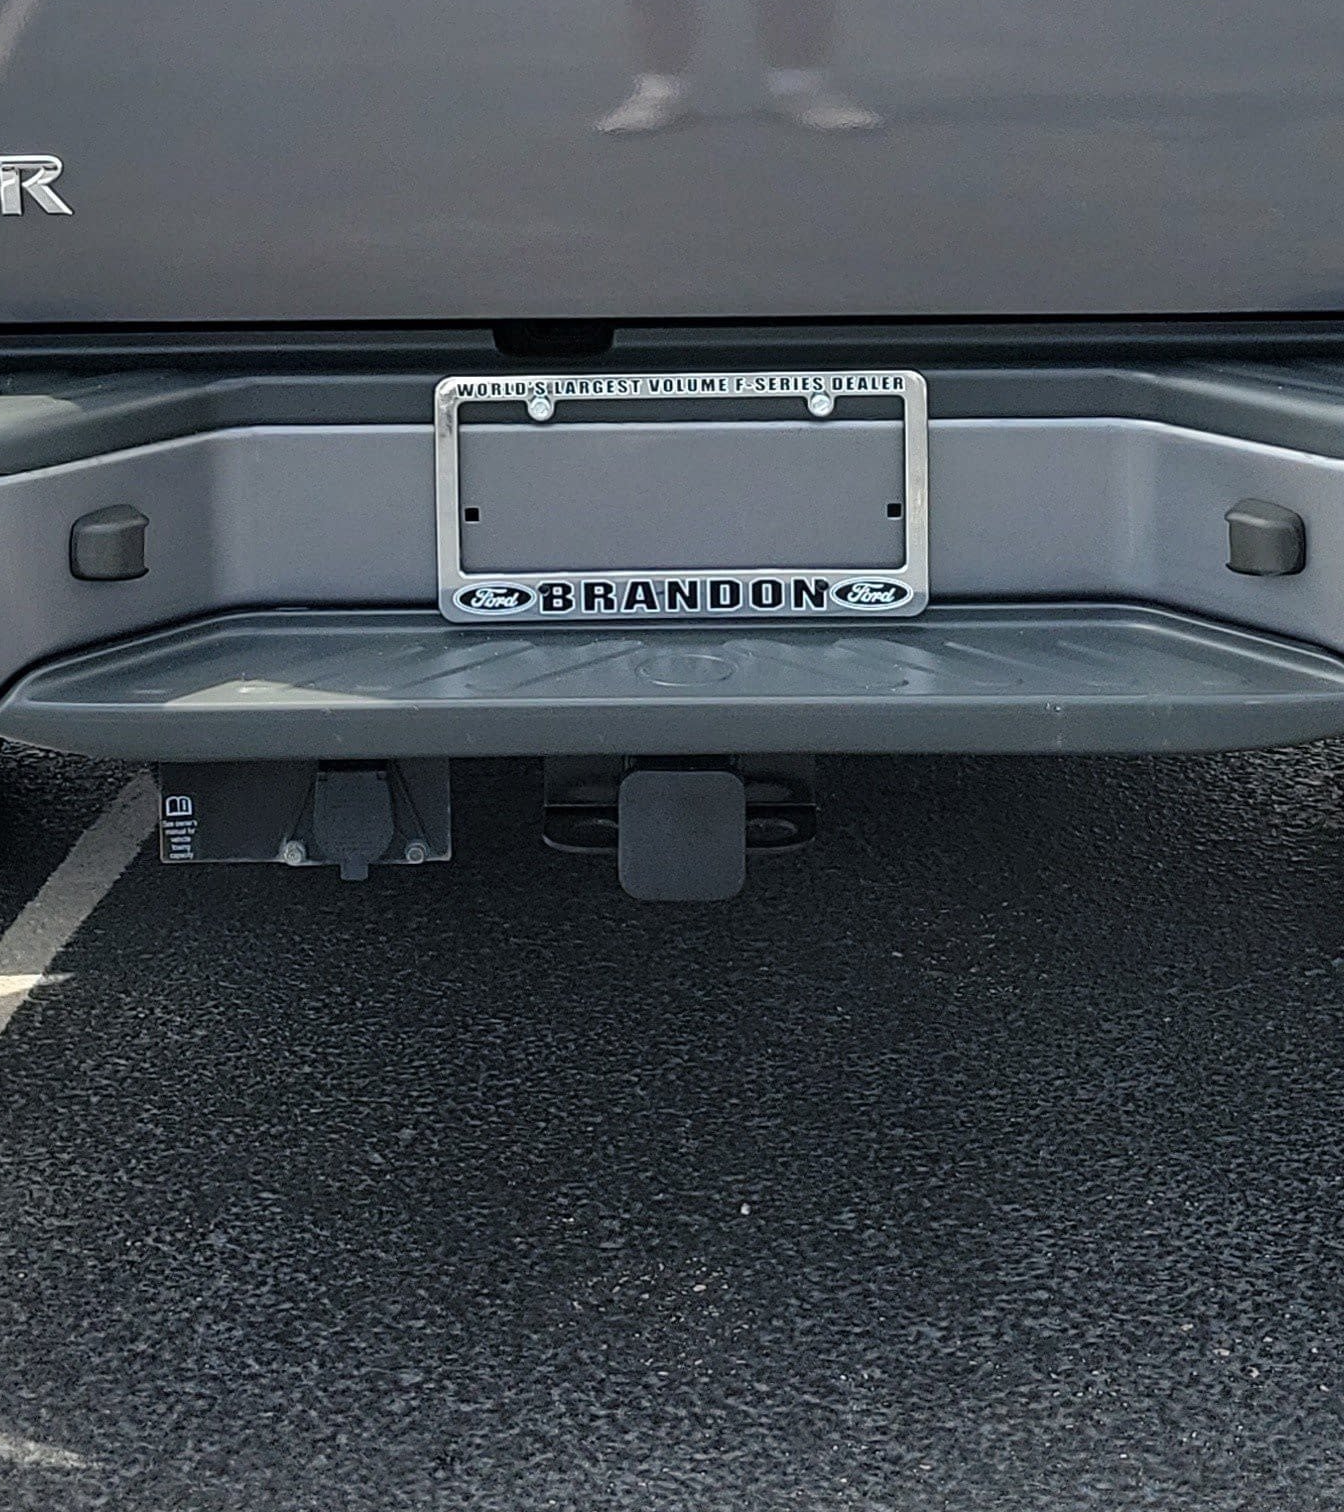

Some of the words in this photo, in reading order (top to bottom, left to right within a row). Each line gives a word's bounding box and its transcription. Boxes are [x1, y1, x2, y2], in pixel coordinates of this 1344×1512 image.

[457, 381, 546, 397] WORLD'S
[555, 379, 641, 394] LARGEST
[649, 378, 727, 393] VOLUME
[736, 377, 824, 392] F-SERIES
[832, 376, 904, 390] DEALER
[470, 587, 520, 609] Ford
[537, 577, 828, 614] BRANDON
[846, 582, 896, 604] Ford
